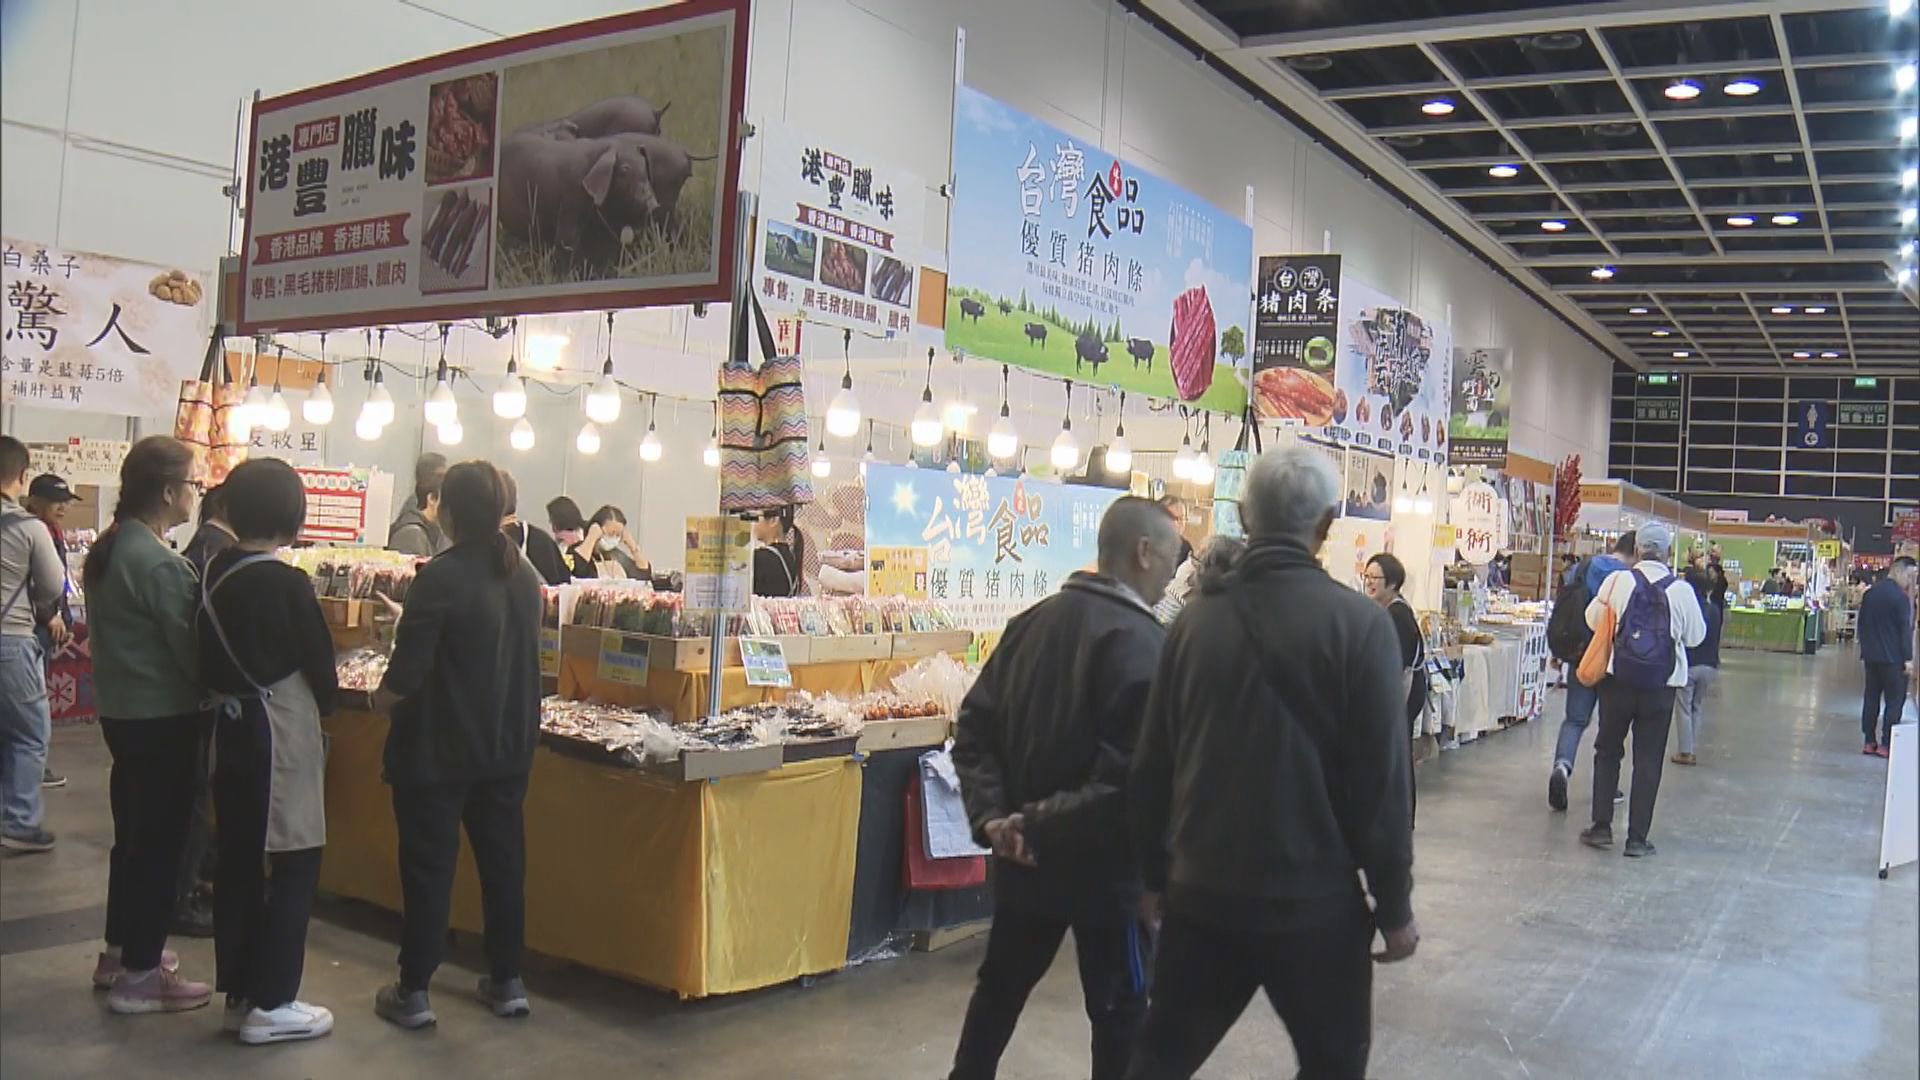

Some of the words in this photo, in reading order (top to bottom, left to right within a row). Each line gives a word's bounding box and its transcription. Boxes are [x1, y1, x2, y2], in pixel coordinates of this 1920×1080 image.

[259, 107, 416, 217] 港豐臘味
[298, 121, 336, 148] 專門店
[802, 148, 894, 221] 港豐臘味
[1017, 140, 1145, 240] 台灣食品
[270, 230, 324, 260] 香港品牌
[334, 220, 391, 251] 香港風味
[807, 210, 845, 235] 香港品牌
[3, 245, 80, 279] 白桑子
[1279, 270, 1320, 289] 台灣
[6, 280, 152, 354] 驚人
[921, 474, 1049, 564] 台灣食品
